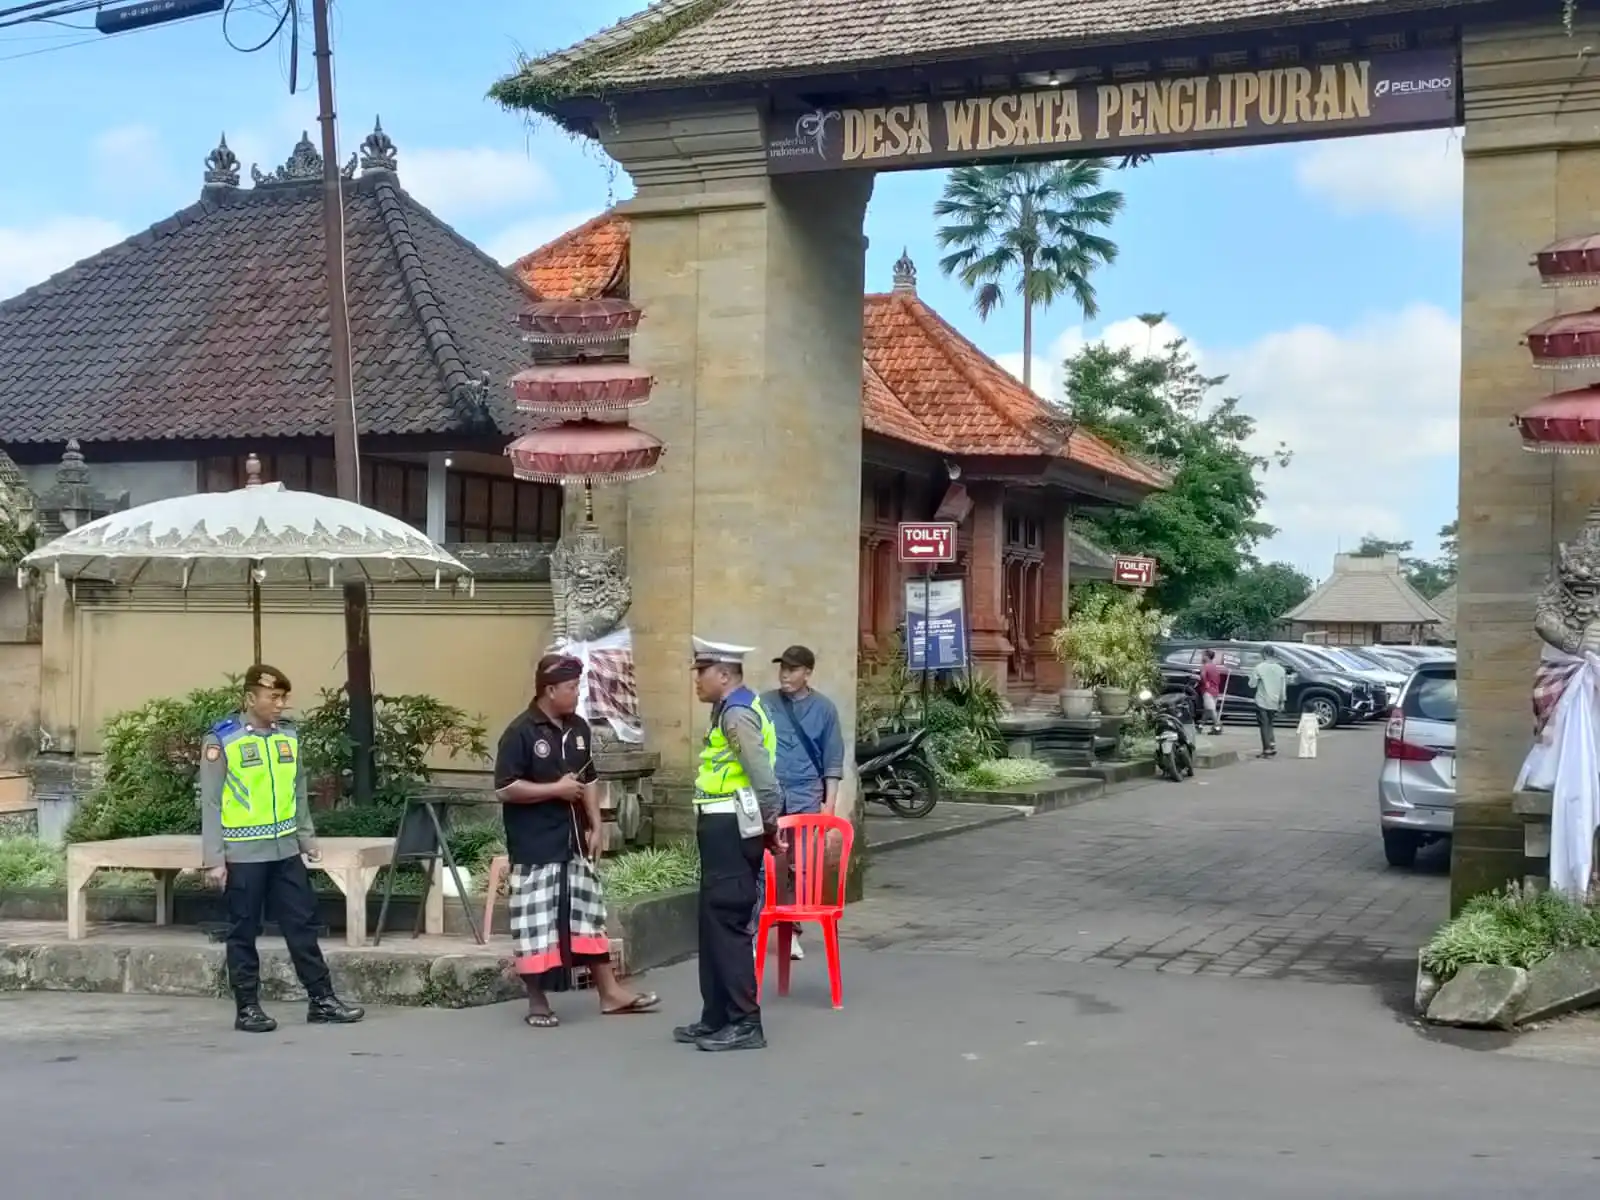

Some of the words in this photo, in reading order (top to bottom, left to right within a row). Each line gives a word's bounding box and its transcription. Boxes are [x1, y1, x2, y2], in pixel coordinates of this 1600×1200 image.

[1391, 78, 1452, 92] PELINDO
[842, 102, 932, 161] DESA
[943, 89, 1083, 151] WISATA
[1095, 60, 1371, 139] PENGLIPURAN
[904, 529, 949, 541] TOILET
[1119, 561, 1150, 571] TOILET
